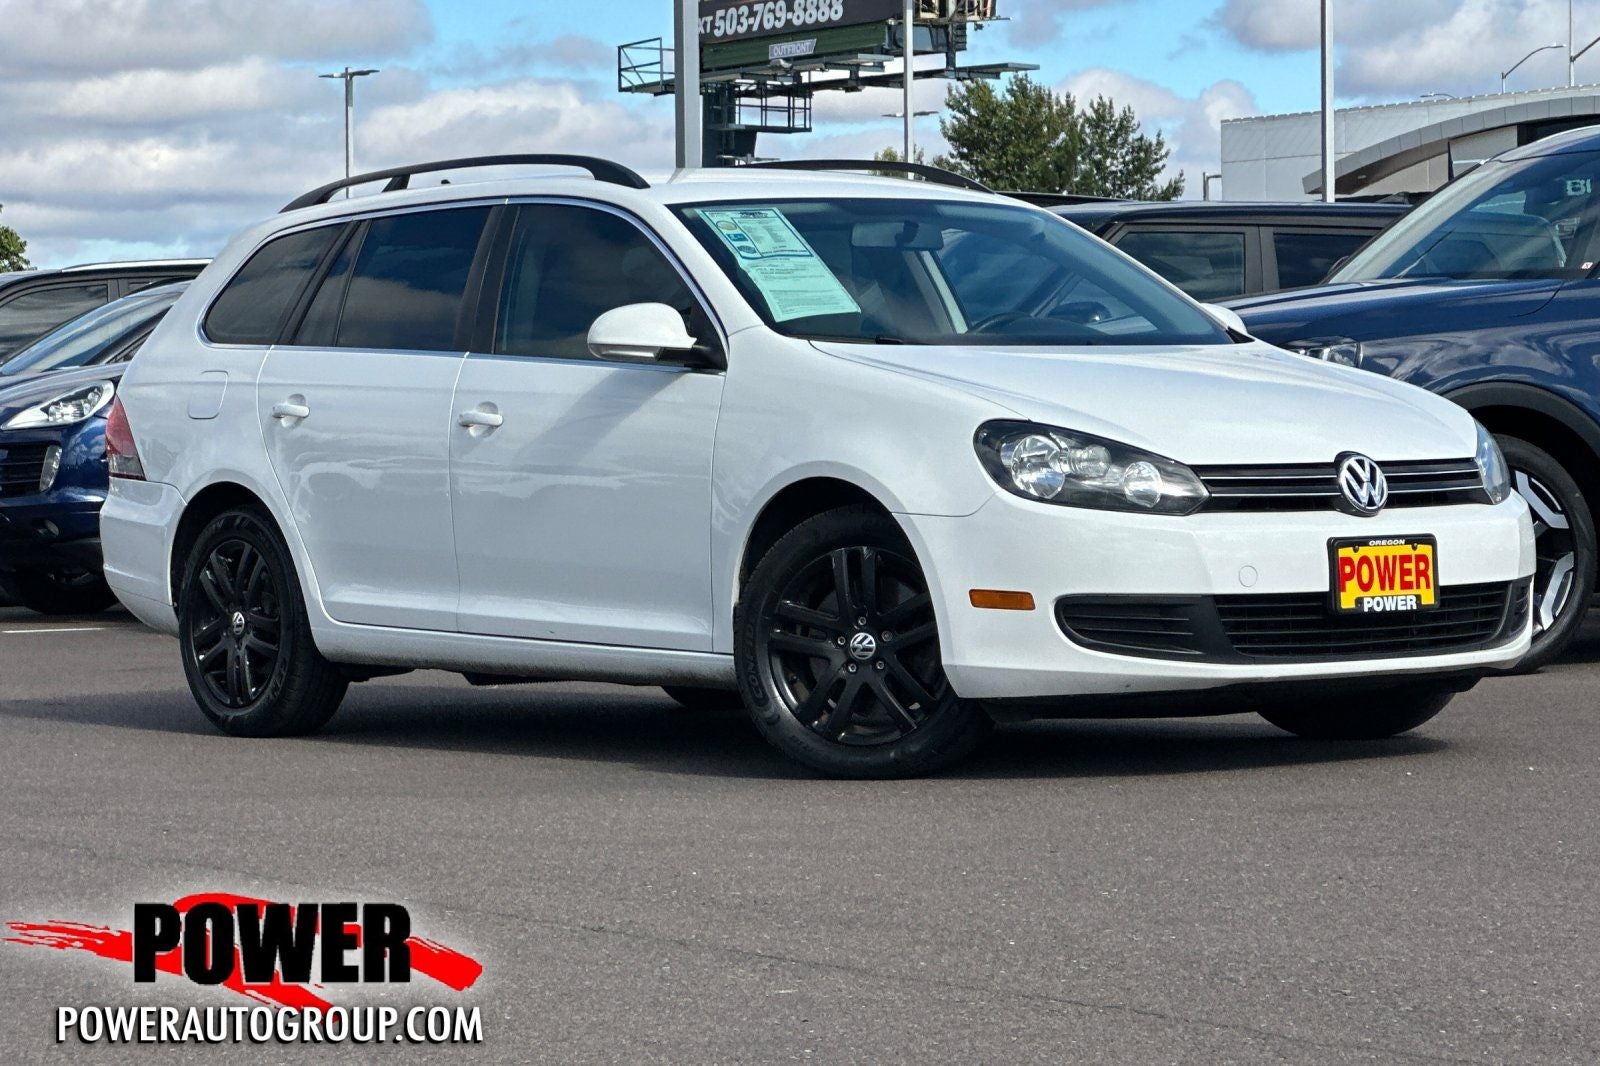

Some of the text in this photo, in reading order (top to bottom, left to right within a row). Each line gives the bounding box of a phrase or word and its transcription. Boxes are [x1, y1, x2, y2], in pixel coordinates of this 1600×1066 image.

[713, 0, 844, 37] 503-769-8888
[773, 42, 812, 57] OUTFRONT
[1368, 538, 1406, 547] OREGON
[1338, 553, 1431, 593] POWER
[1363, 595, 1417, 612] POWER
